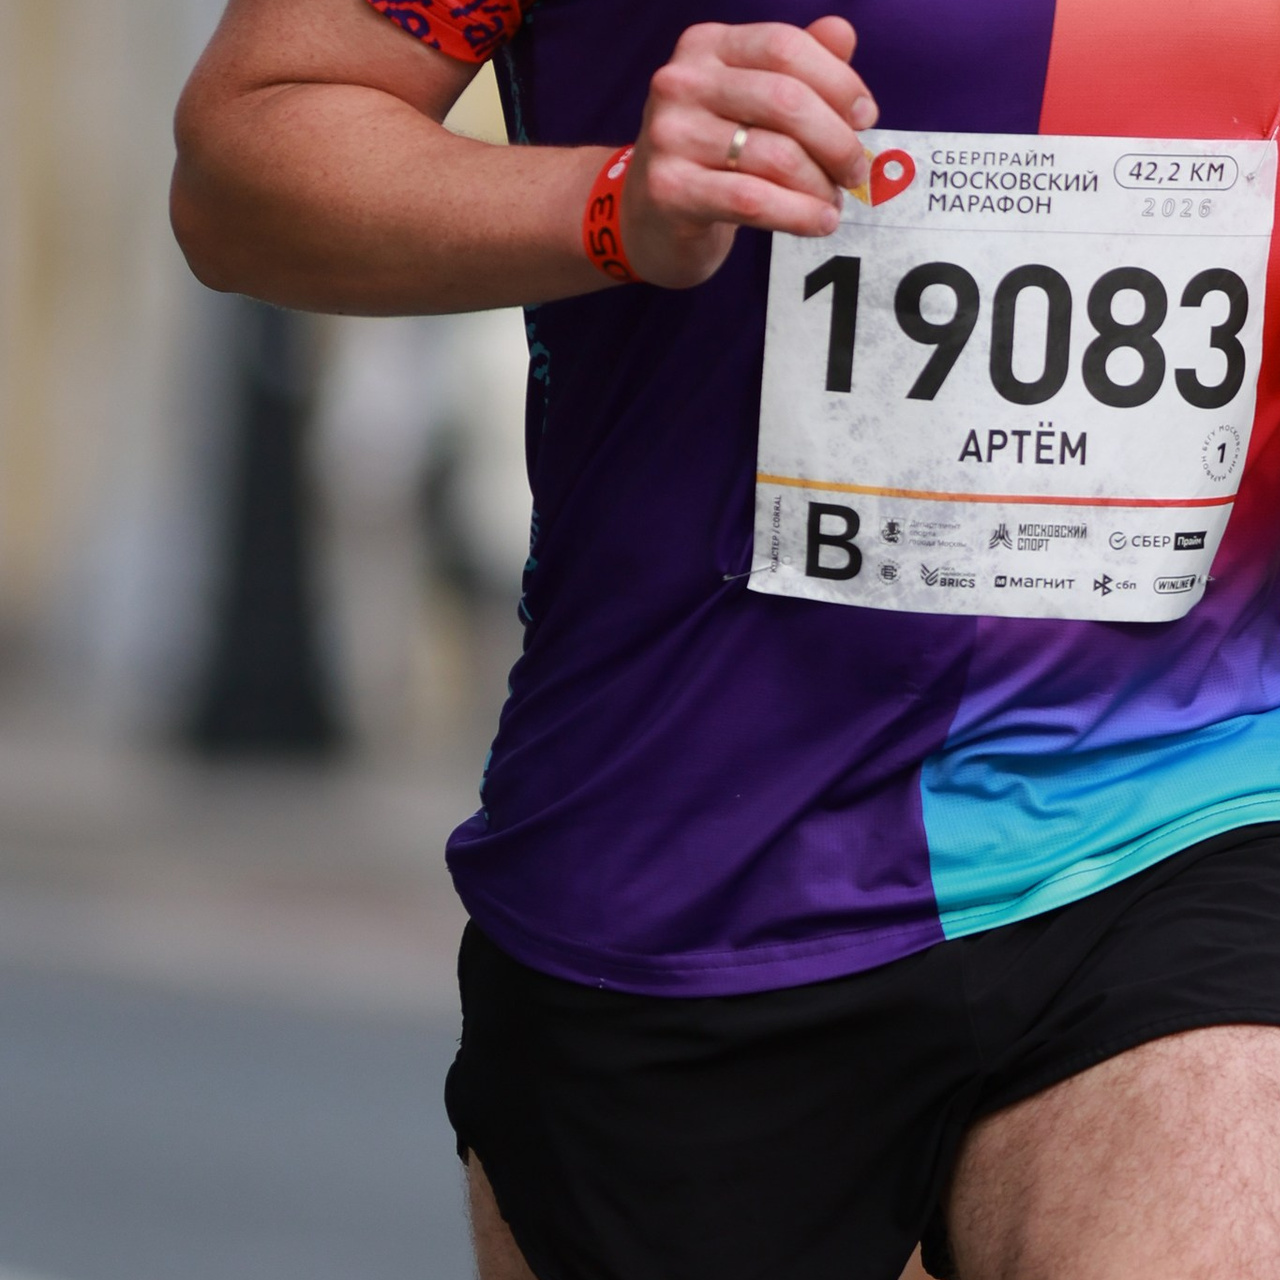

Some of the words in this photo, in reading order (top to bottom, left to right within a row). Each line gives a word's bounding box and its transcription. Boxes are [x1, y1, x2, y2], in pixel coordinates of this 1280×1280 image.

[931, 150, 1055, 167] СБЕРПРАЙМ
[929, 170, 1098, 192] МОСКОВСКИЙ
[1128, 161, 1182, 184] 42,2
[928, 194, 1052, 214] МАРАФОН
[1141, 197, 1212, 218] 2026
[803, 254, 1250, 410] 19083
[958, 421, 1088, 466] АРТЁМ
[1217, 442, 1227, 464] 1
[1017, 523, 1088, 539] МОСКОВСКИЙ
[1017, 538, 1051, 551] СПОРТ
[1131, 535, 1171, 548] СБЕР
[940, 578, 976, 588] BRICS
[1009, 577, 1076, 590] магнит
[1158, 578, 1190, 590] WINLINE
